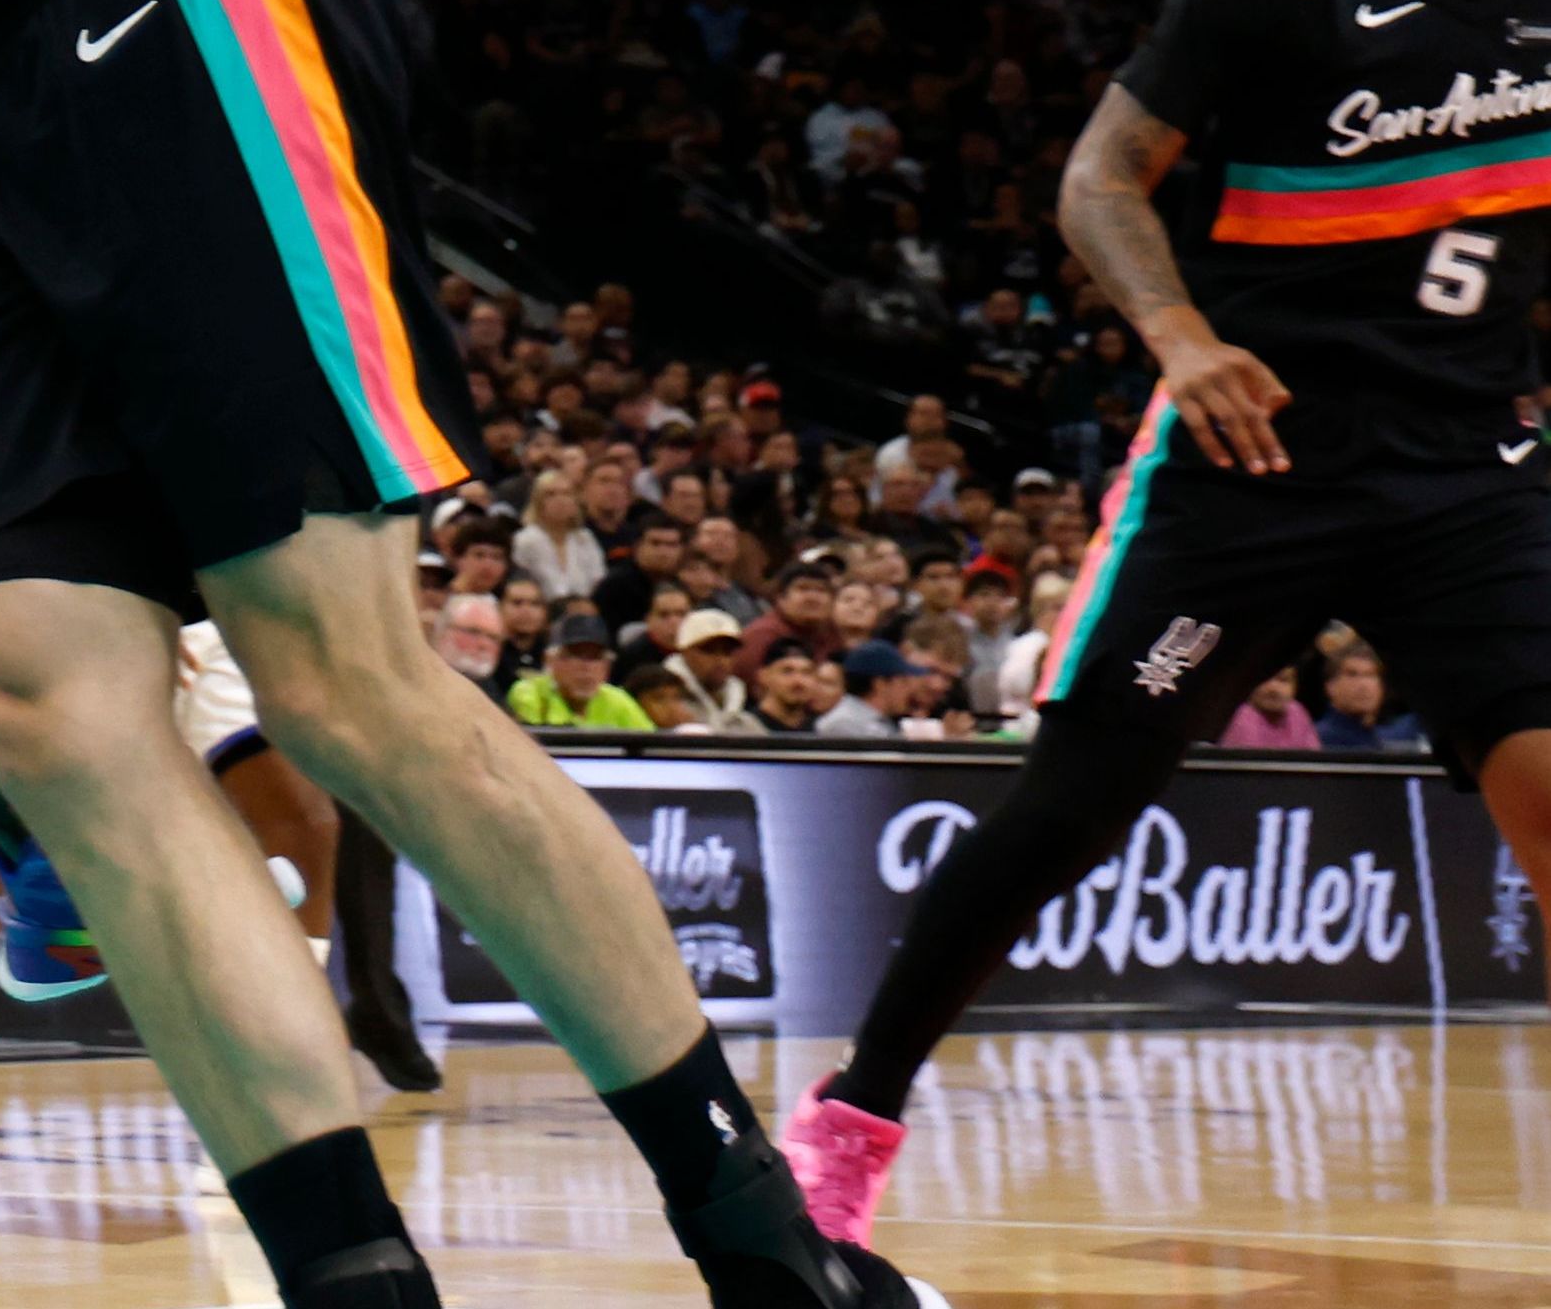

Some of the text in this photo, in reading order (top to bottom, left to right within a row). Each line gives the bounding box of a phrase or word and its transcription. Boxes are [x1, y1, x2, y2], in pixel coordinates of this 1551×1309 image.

[1326, 90, 1427, 158] San
[1417, 228, 1503, 318] 5
[876, 798, 1411, 976] oBaller
